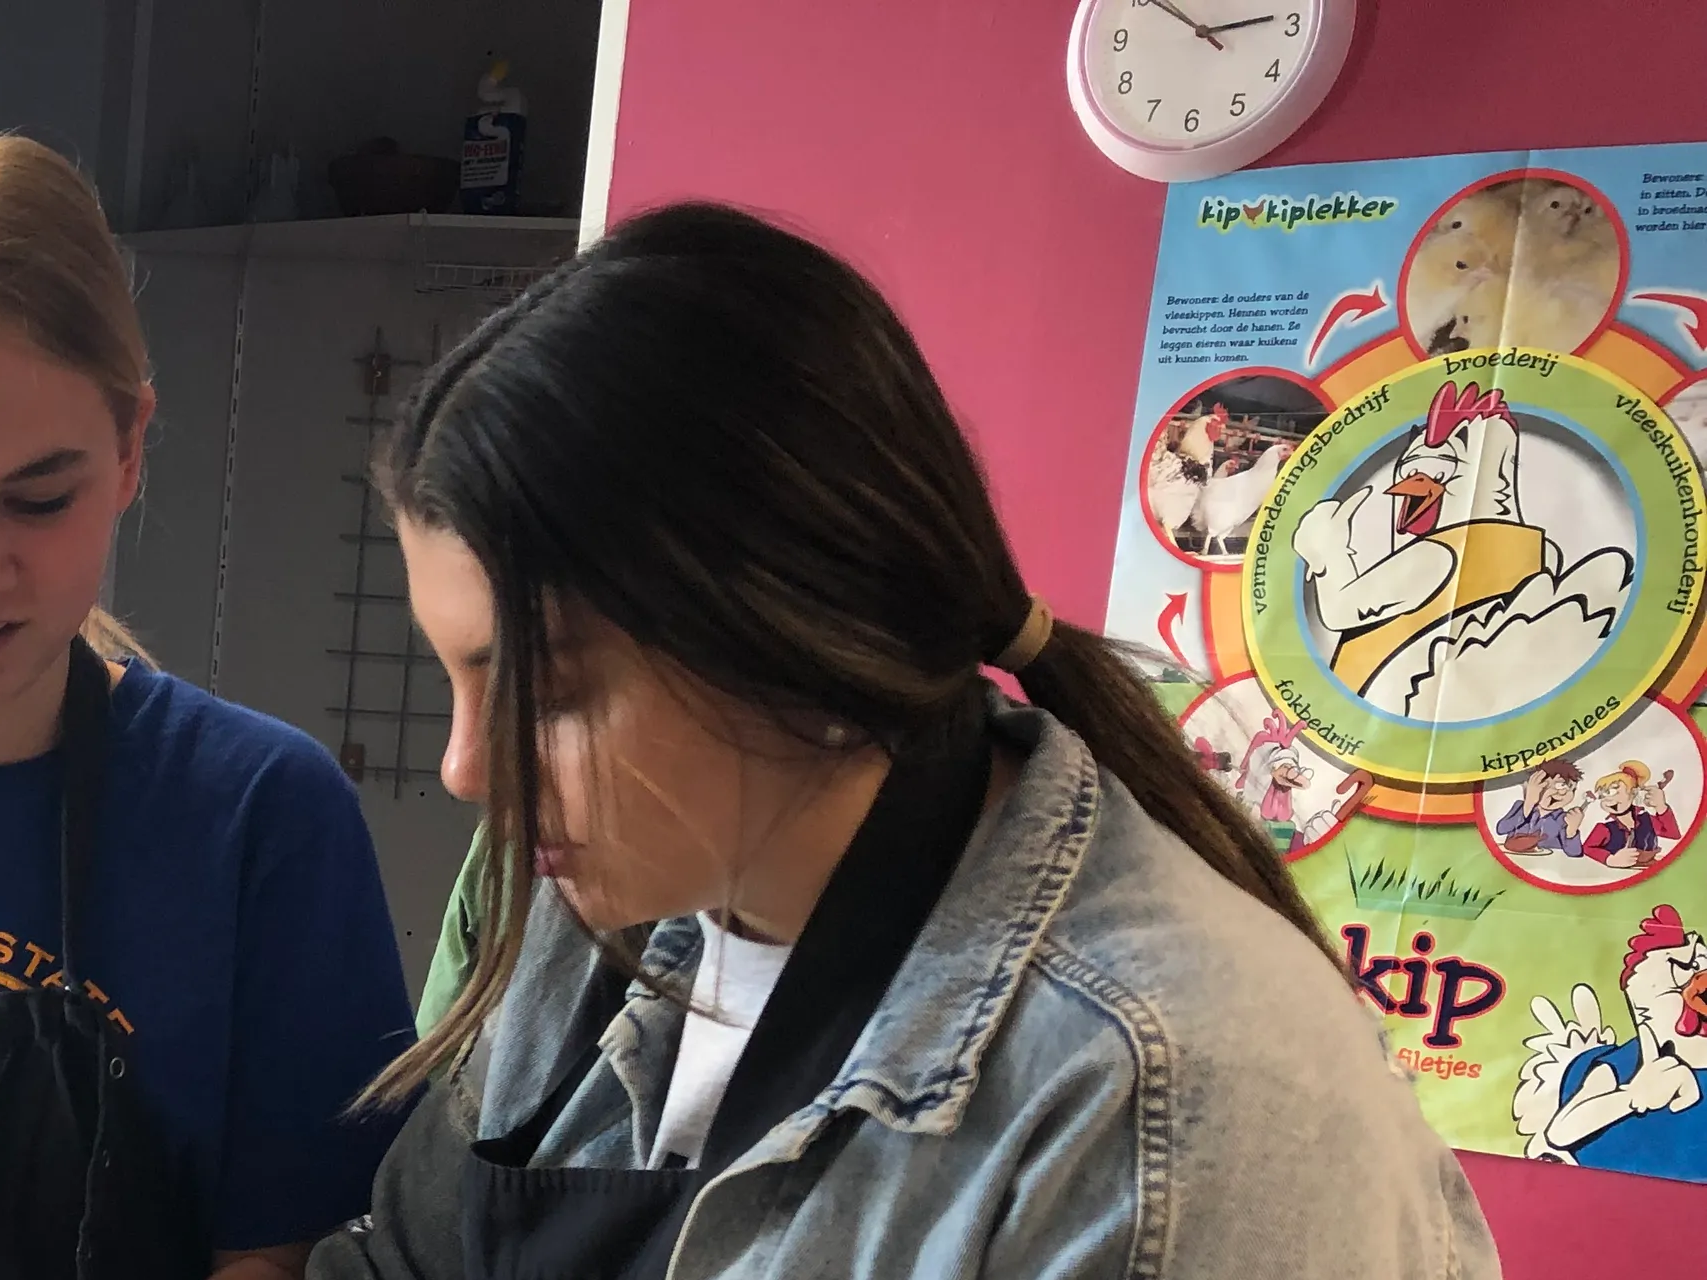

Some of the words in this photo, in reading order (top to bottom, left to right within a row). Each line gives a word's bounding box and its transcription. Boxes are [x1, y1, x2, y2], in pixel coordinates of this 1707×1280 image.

[1284, 13, 1301, 37] 3
[1113, 29, 1129, 52] 9
[1264, 59, 1281, 82] 4
[1117, 71, 1133, 94] 8
[1147, 99, 1162, 122] 7
[1229, 93, 1246, 117] 5
[1184, 109, 1200, 132] 6
[1640, 190, 1652, 199] in
[1201, 200, 1241, 230] kip
[1266, 195, 1395, 230] kiplekker
[1637, 206, 1650, 216] in
[1635, 221, 1679, 232] worden
[1222, 293, 1234, 304] de
[1237, 292, 1272, 303] ouders
[1274, 293, 1294, 301] van
[1296, 290, 1310, 301] de
[1228, 308, 1267, 318] Hennen
[1270, 306, 1309, 316] worden
[1162, 325, 1208, 335] bevrucht
[1210, 323, 1234, 333] door
[1236, 322, 1249, 333] de
[1287, 321, 1301, 331] Ze
[1160, 340, 1193, 352] leggen
[1195, 339, 1227, 348] eieren
[1229, 339, 1255, 348] waar
[1257, 336, 1298, 347] kuikens
[1158, 355, 1173, 364] uit
[1174, 354, 1211, 363] kunnen
[1442, 346, 1560, 378] broederij
[1253, 383, 1391, 616] vermeerderingsbedrijf
[1615, 394, 1704, 615] vleeskuikenhouderij
[1274, 679, 1365, 756] fokbedrijf
[1480, 695, 1621, 773] kippenvlees
[1341, 923, 1507, 1049] kip
